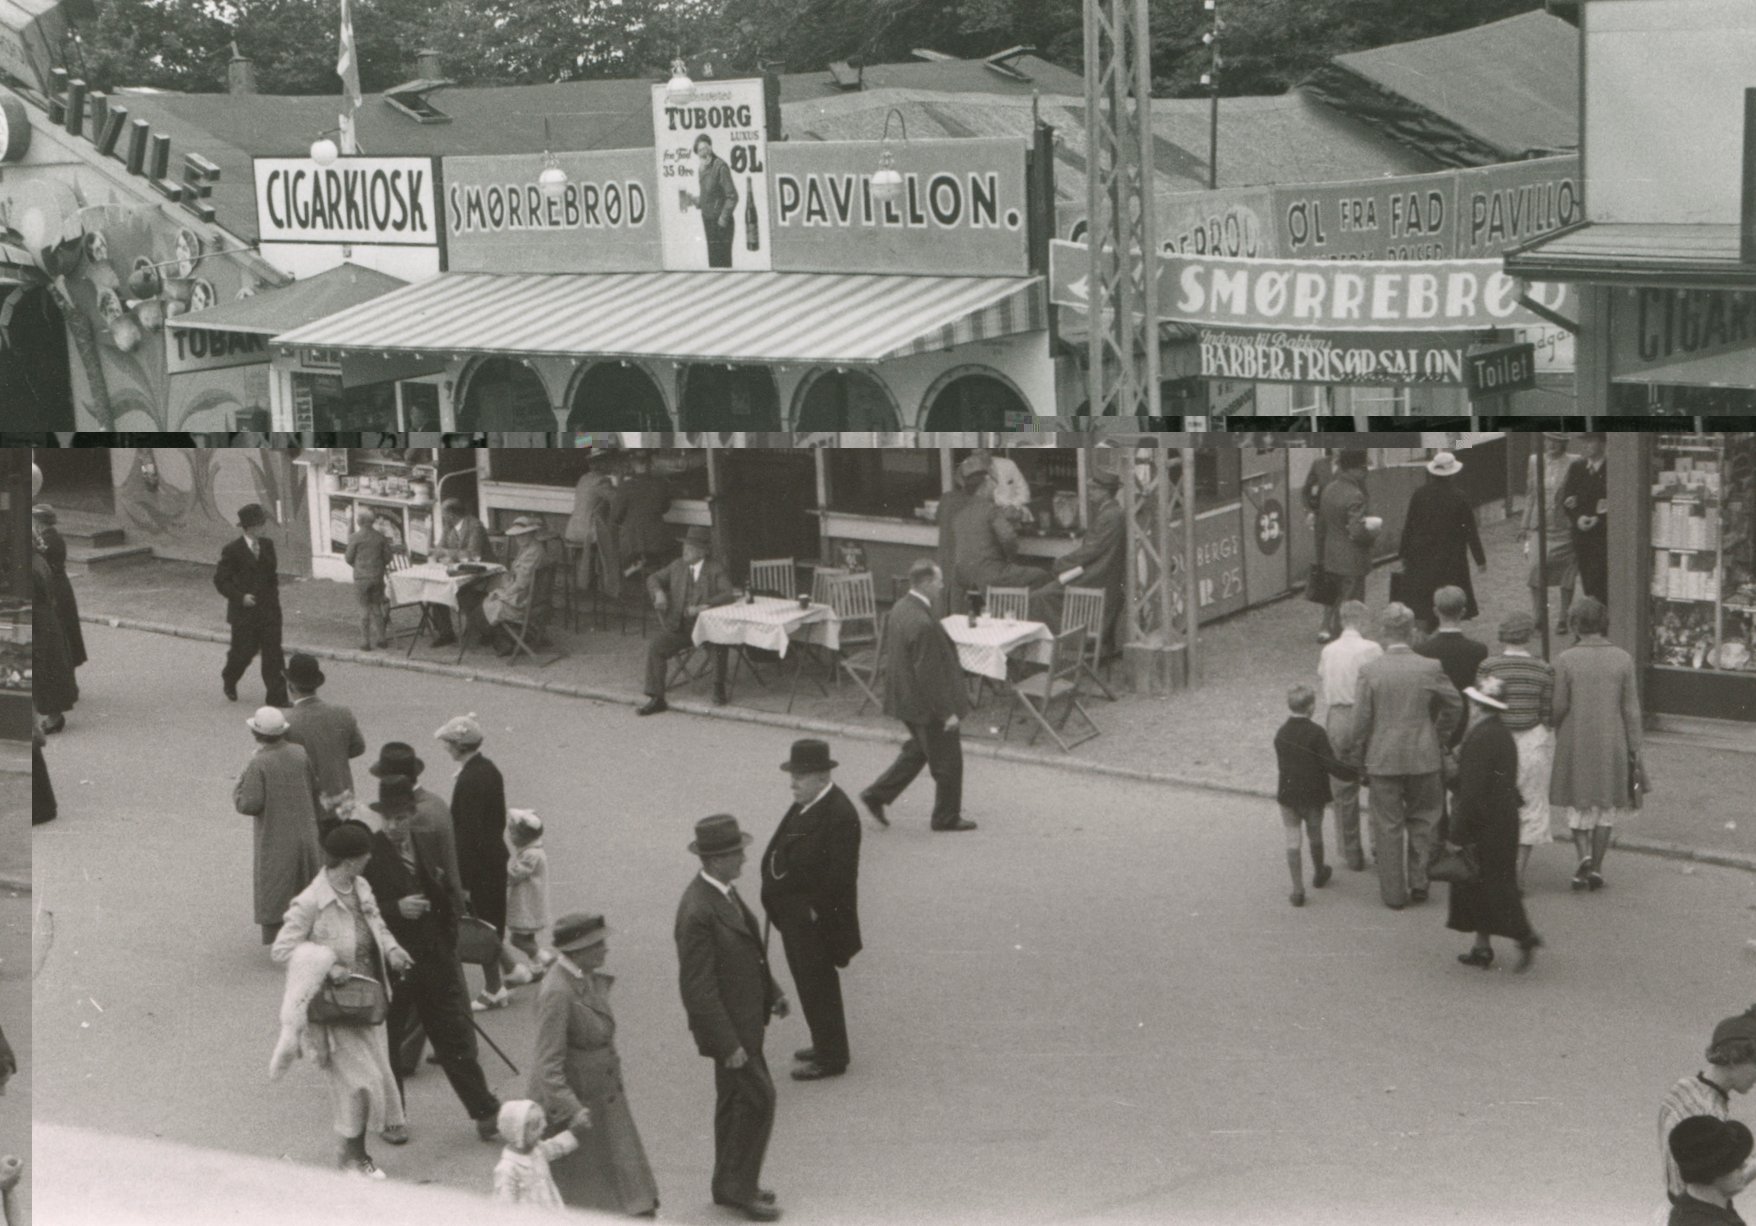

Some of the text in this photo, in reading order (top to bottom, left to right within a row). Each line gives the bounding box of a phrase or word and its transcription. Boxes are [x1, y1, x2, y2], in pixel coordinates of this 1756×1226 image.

[664, 104, 752, 131] TUBORG
[730, 131, 760, 141] LUXUS
[663, 165, 675, 178] 35
[730, 144, 763, 174] ØL
[266, 169, 427, 232] CIGARKIOSK
[450, 180, 647, 234] SMØRREBRØD
[1288, 202, 1325, 248] ØL
[1340, 199, 1378, 231] FRA
[1390, 191, 1444, 238] FAD
[1177, 263, 1566, 318] SMØRREBRØD
[1200, 343, 1284, 379] BARBER
[1474, 354, 1527, 389] Toilet
[1260, 512, 1280, 541] 35
[1222, 567, 1243, 599] 25
